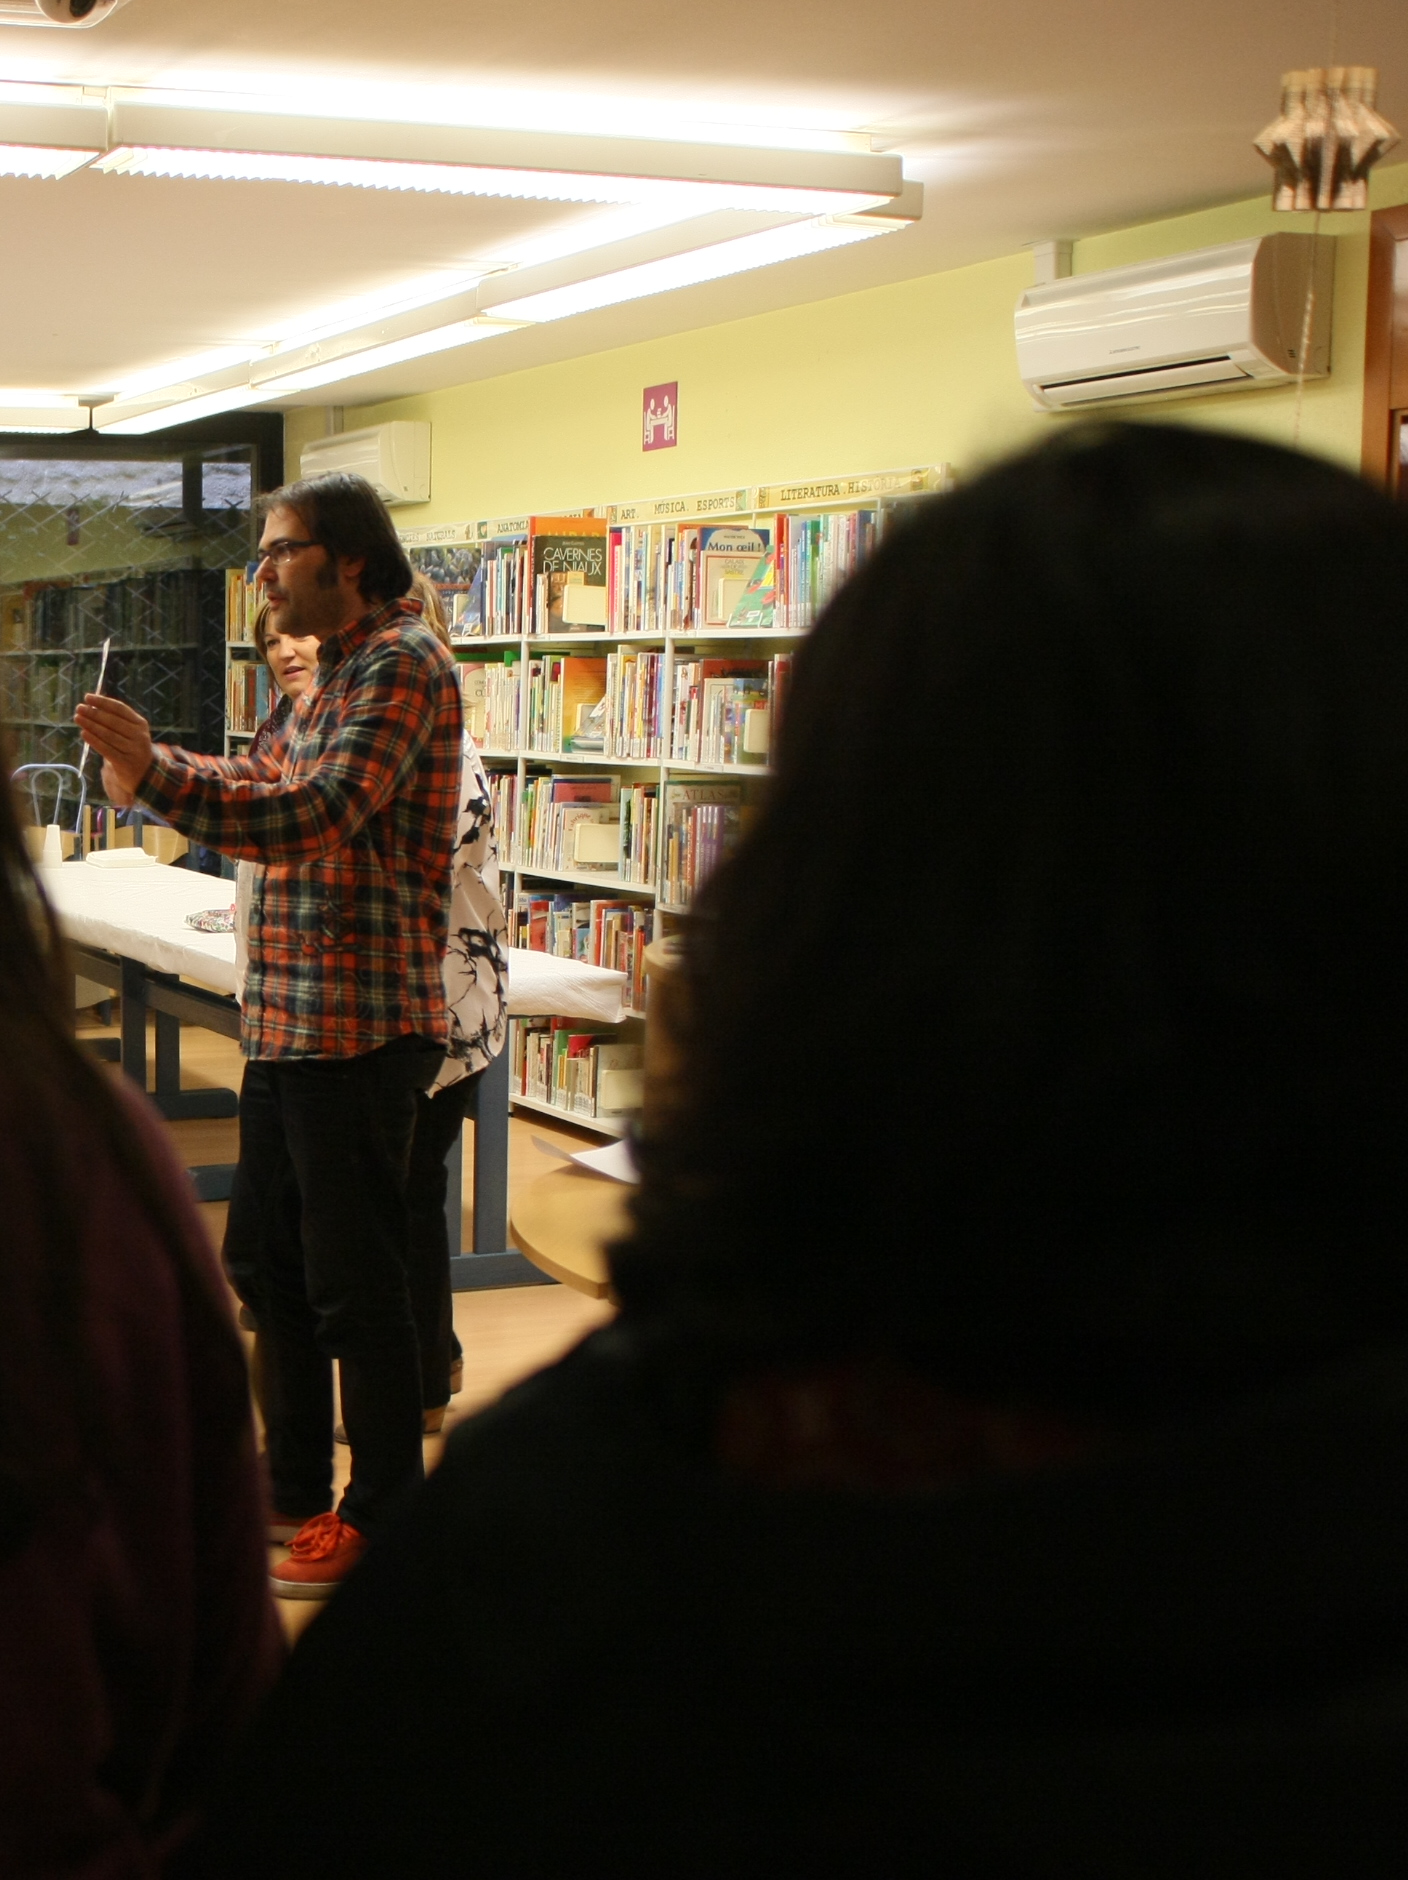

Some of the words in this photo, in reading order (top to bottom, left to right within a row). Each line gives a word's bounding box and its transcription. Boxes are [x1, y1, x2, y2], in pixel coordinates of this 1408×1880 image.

[620, 509, 639, 520] ART.
[654, 501, 689, 515] MÚSICA.
[696, 496, 735, 511] ESPORTS
[707, 541, 733, 552] Mon
[736, 541, 755, 552] œil
[543, 546, 603, 562] CAVERNES
[682, 789, 725, 801] ATLAS
